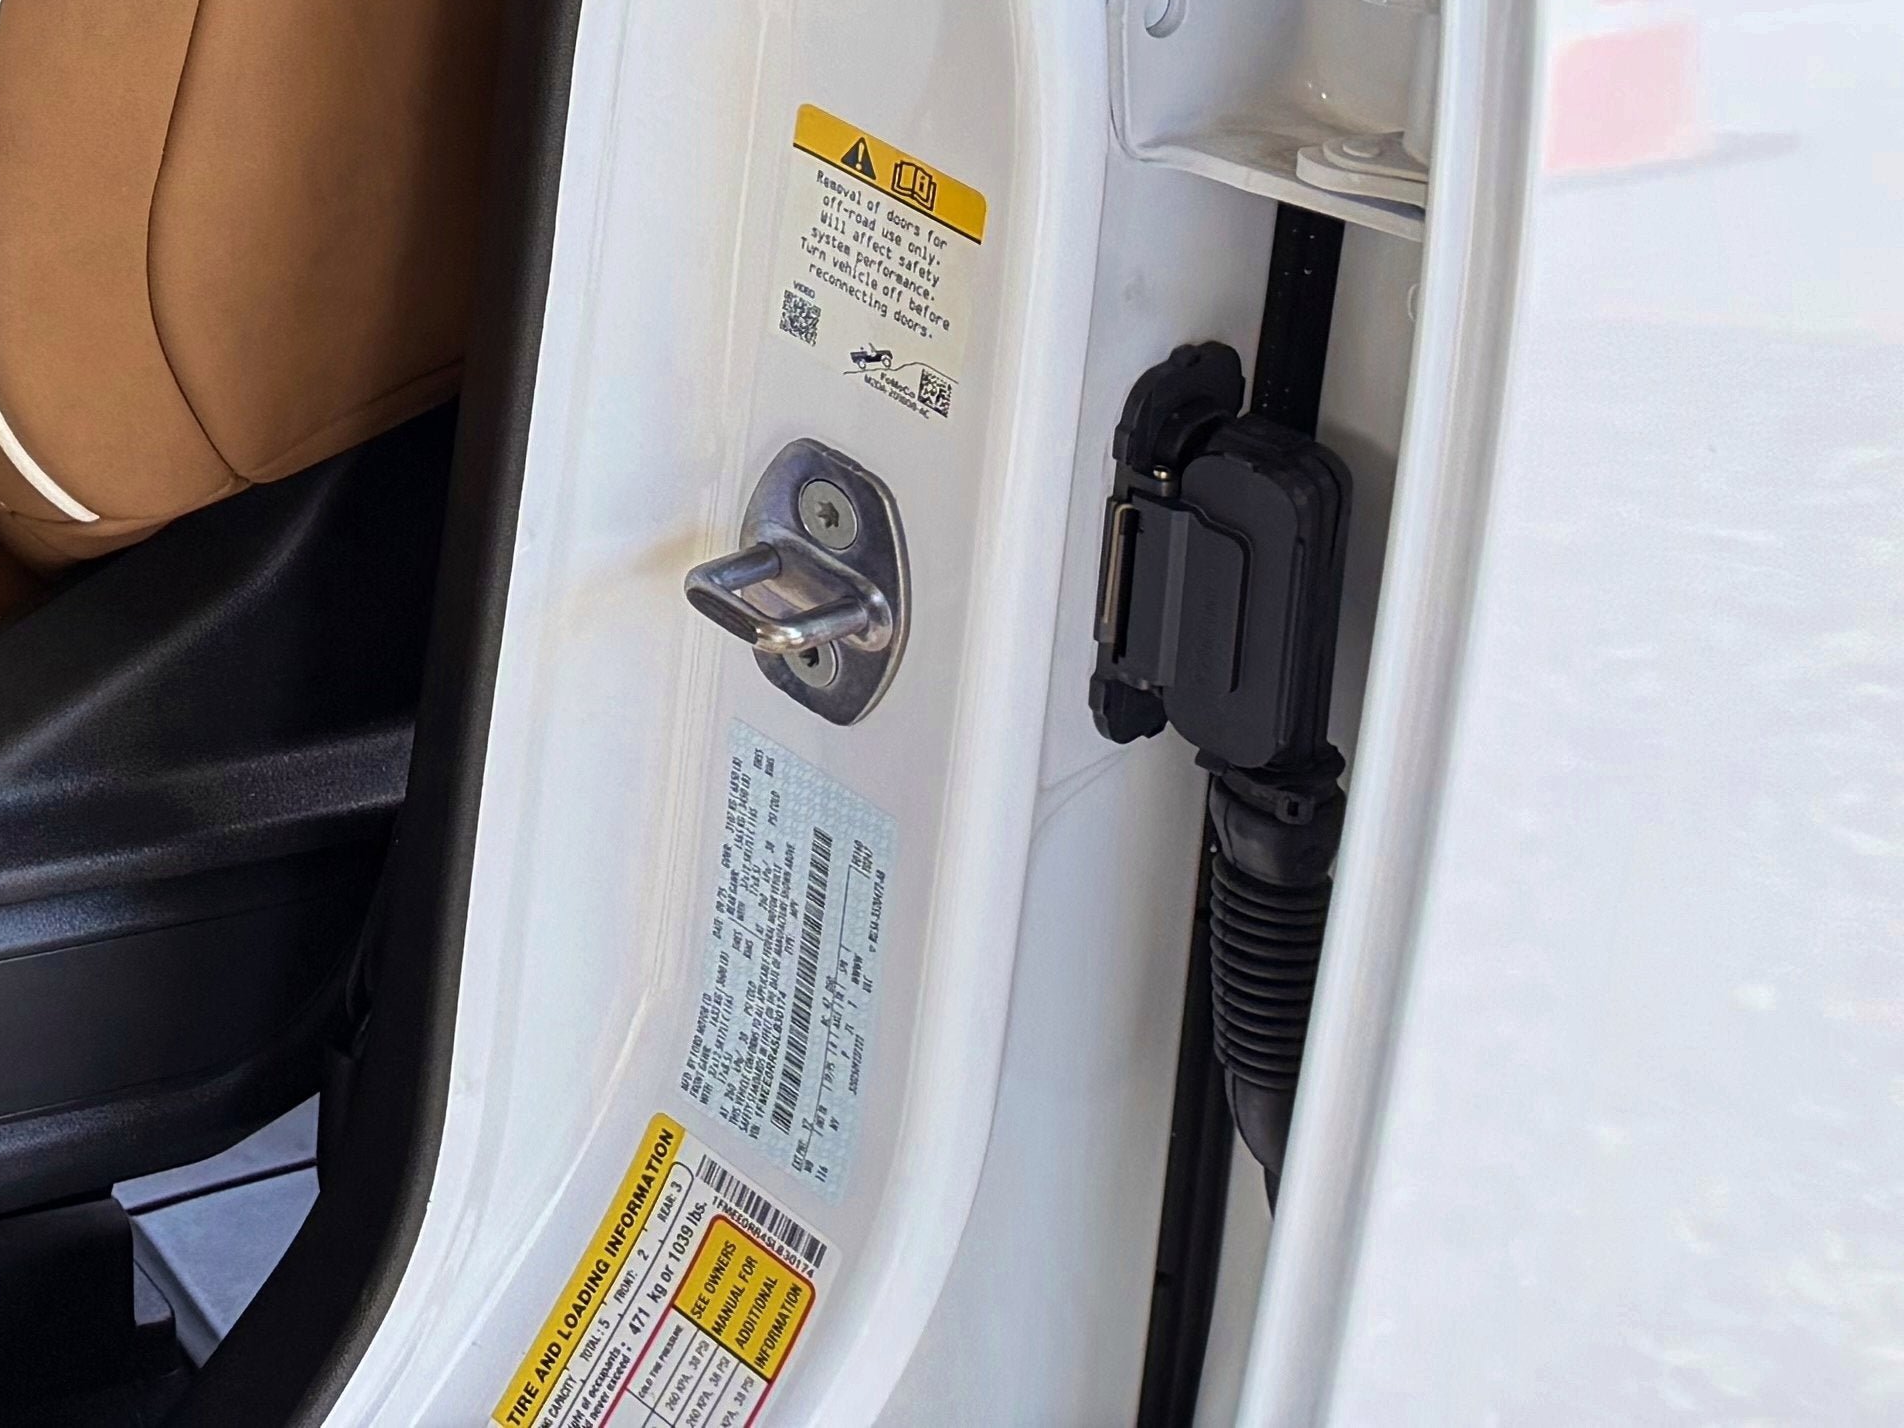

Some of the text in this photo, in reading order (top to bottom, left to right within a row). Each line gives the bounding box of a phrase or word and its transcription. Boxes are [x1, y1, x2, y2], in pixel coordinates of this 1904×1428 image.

[816, 169, 947, 249] Removal of doors for
[822, 195, 940, 266] off-road use only.
[800, 235, 950, 331] Turn vehicle off before
[810, 226, 934, 301] system performance.
[819, 209, 939, 287] Will affect safety
[792, 280, 815, 299] VIDEO
[808, 263, 932, 338] reconnecting doors.
[767, 895, 777, 923] MOTOR
[770, 863, 781, 894] VEHICLE
[763, 925, 774, 957] FEDERAL
[757, 958, 769, 1003] APPLICABLE
[690, 1035, 702, 1057] FORD
[697, 1006, 708, 1034] MOTOR
[744, 1031, 758, 1072] CONFORMS
[728, 1106, 740, 1125] THIS
[735, 1071, 749, 1107] VEHICLE
[738, 1099, 752, 1132] SAFETY
[747, 1056, 764, 1104] STANDARDS
[505, 1128, 673, 1428] TIRE AND LOADING INFORMATION
[547, 1374, 576, 1418] CAPACITY
[597, 1317, 610, 1329] 5
[612, 1269, 637, 1303] FRONT:
[636, 1248, 649, 1261] 2
[656, 1193, 676, 1222] REAR:
[669, 1180, 682, 1193] 3
[628, 1201, 707, 1335] 471 kg or 1039 lbs.
[689, 1240, 736, 1319] SEE OWNERS
[711, 1255, 758, 1336] MANUAL FOR
[734, 1276, 777, 1349] ADDITIONAL
[754, 1282, 802, 1369] INFORMATION
[580, 1395, 591, 1410] of
[588, 1346, 621, 1398] occupants
[589, 1353, 630, 1420] never exceed
[664, 1391, 680, 1411] 260
[687, 1354, 701, 1370] 38
[694, 1339, 710, 1357] PSI
[685, 1407, 701, 1428] 260
[708, 1371, 722, 1387] 38
[715, 1355, 731, 1373] PSI
[733, 1391, 746, 1407] 38
[740, 1375, 754, 1393] PSI
